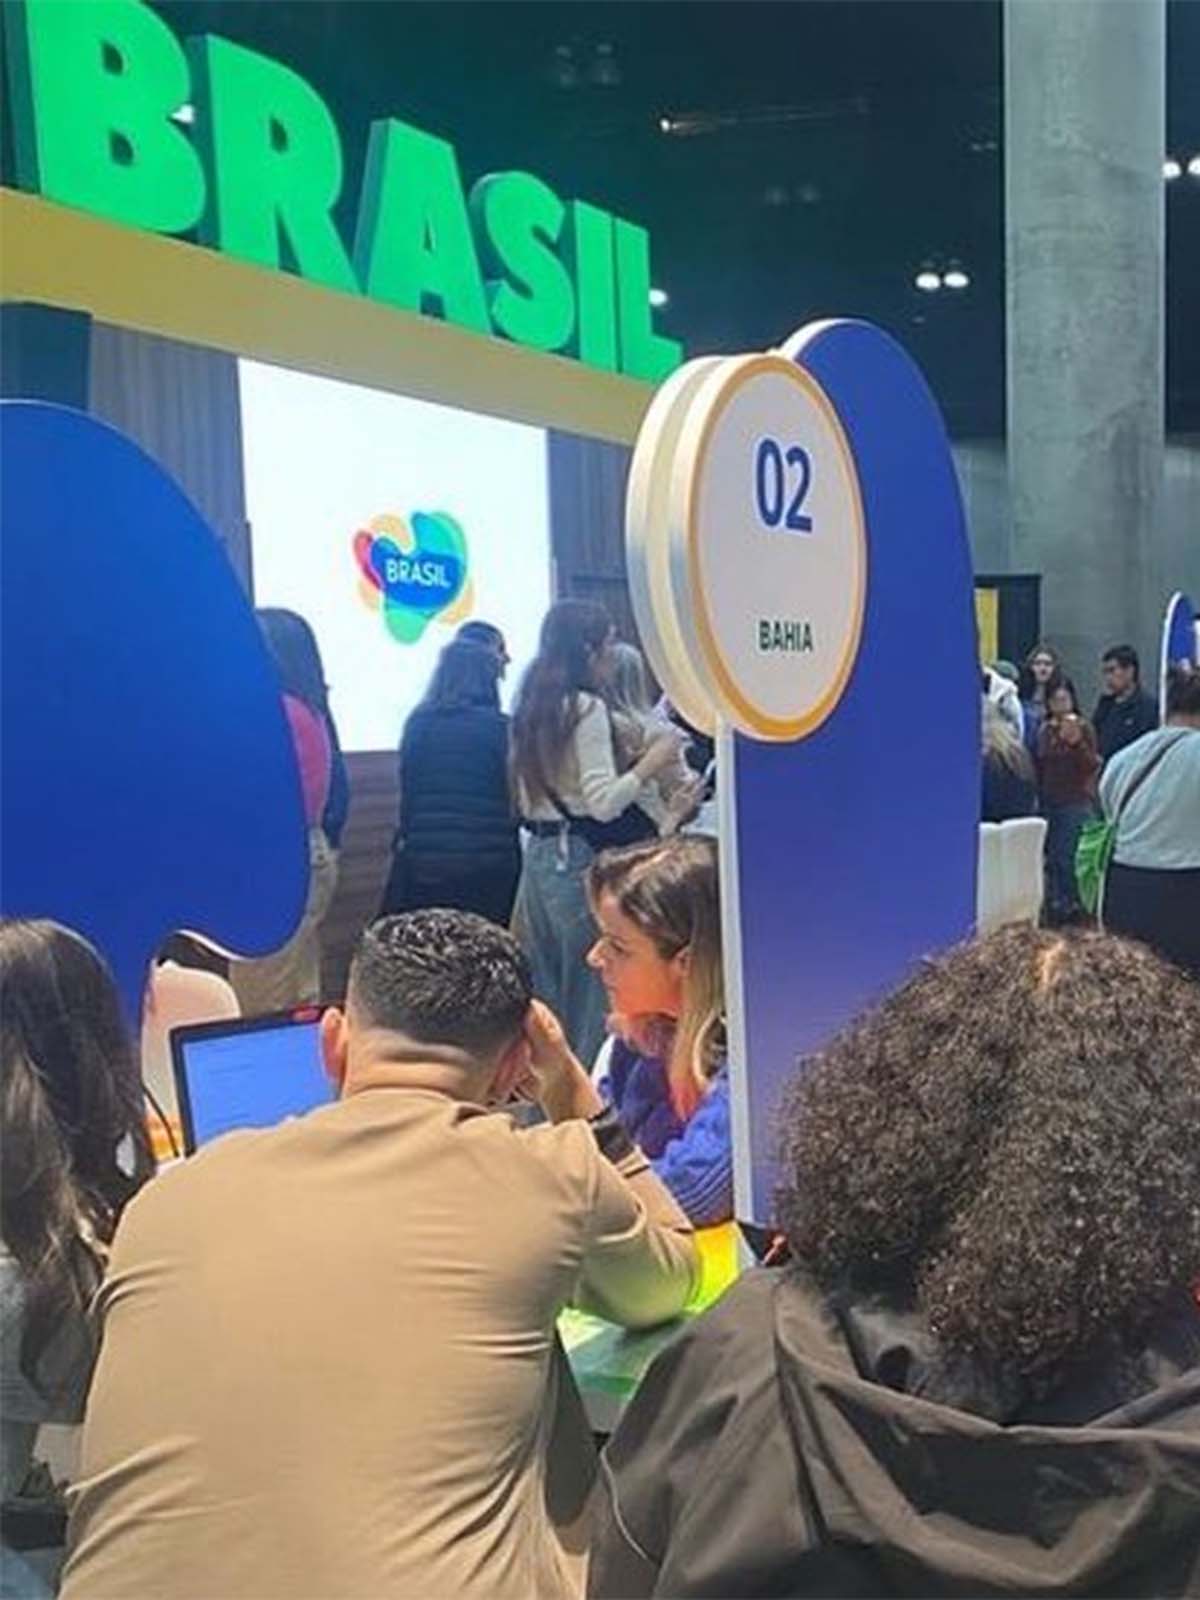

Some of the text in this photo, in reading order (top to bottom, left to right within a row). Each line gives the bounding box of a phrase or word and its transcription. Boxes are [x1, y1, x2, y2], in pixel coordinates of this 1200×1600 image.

[12, 0, 682, 384] BRASIL
[756, 439, 813, 533] 02
[385, 558, 452, 589] BRASIL
[758, 620, 814, 653] BAHIA
